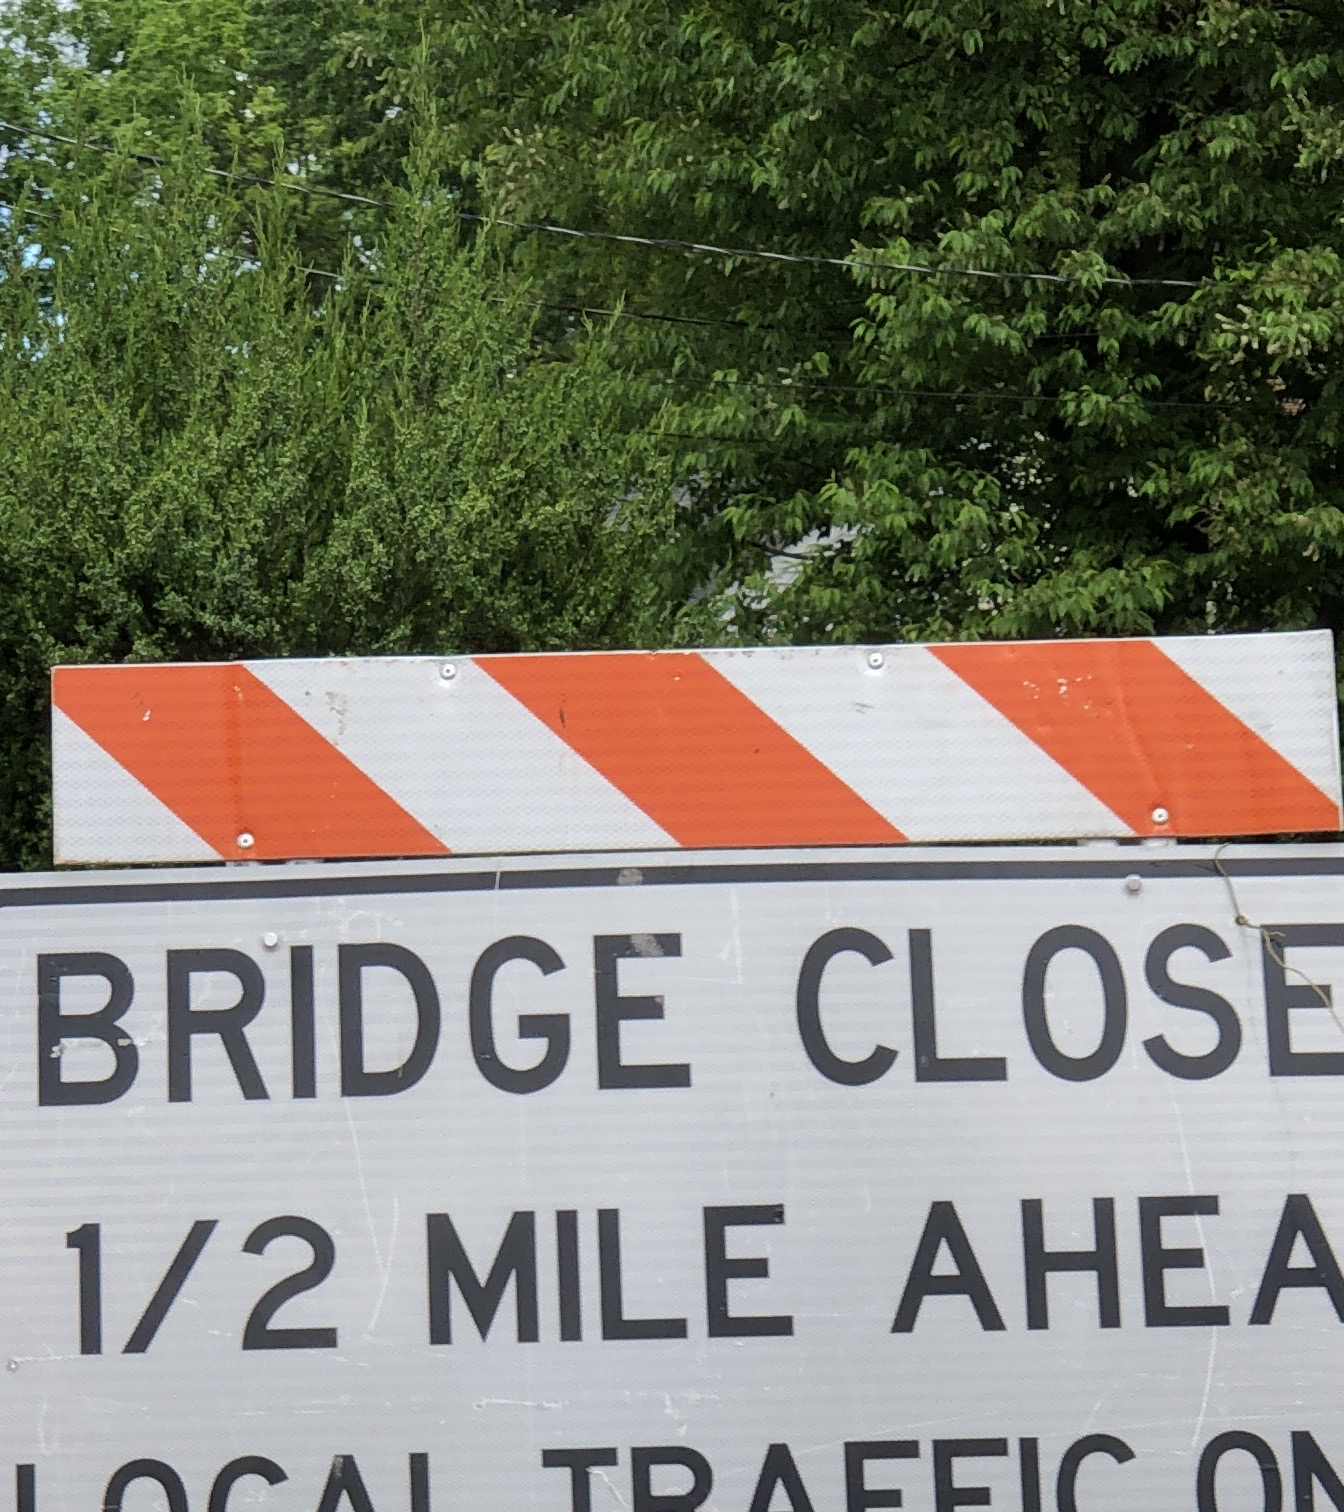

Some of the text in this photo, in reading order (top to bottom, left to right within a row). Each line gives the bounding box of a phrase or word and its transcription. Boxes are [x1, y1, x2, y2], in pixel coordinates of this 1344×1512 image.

[37, 933, 692, 1107] BRIDGE
[66, 1215, 339, 1356] 1/2
[426, 1203, 794, 1347] MILE
